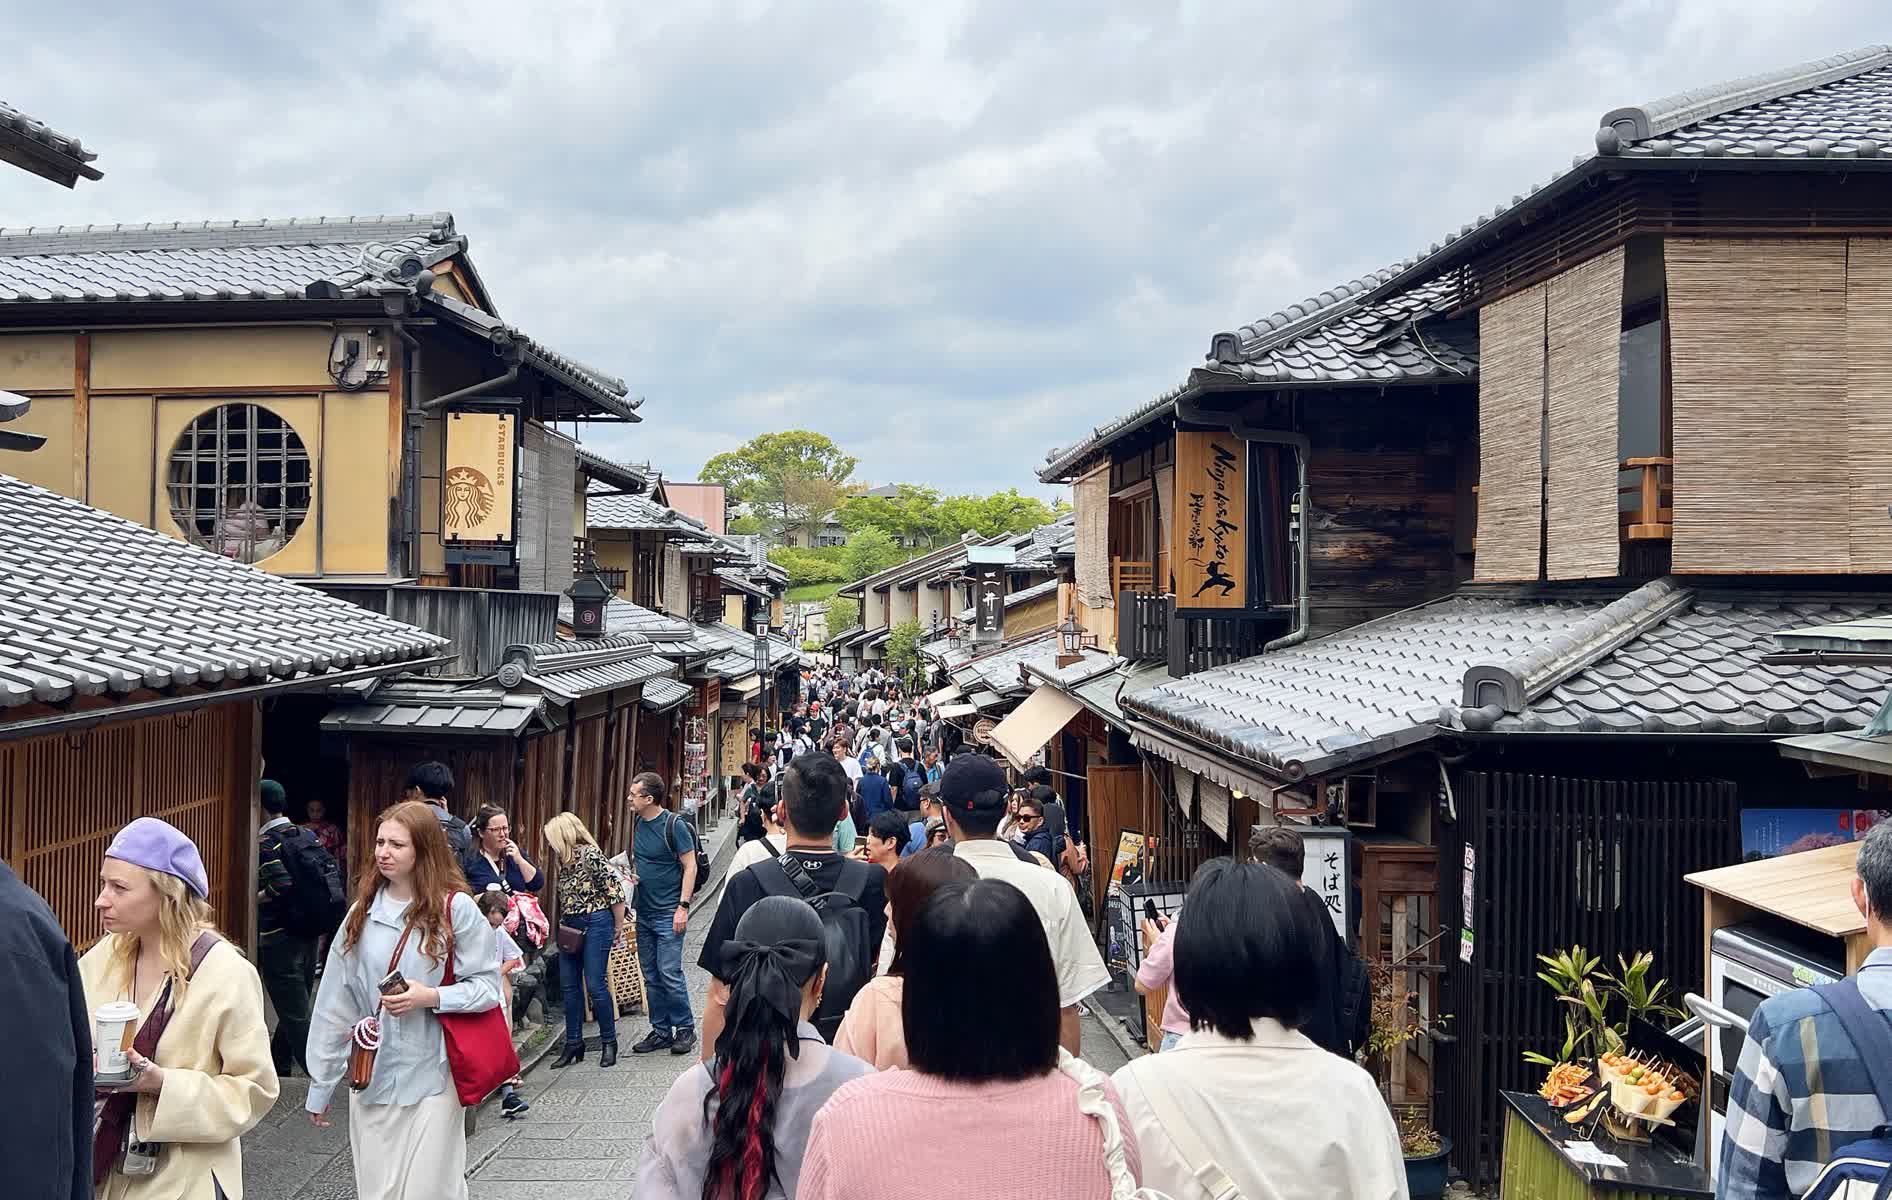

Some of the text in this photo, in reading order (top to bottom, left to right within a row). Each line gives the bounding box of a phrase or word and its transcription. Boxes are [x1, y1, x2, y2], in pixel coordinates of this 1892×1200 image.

[497, 423, 506, 486] STARBUCKS
[1206, 443, 1237, 490] Ninja
[1208, 519, 1238, 560] Kyoto
[1324, 851, 1342, 913] そば処
